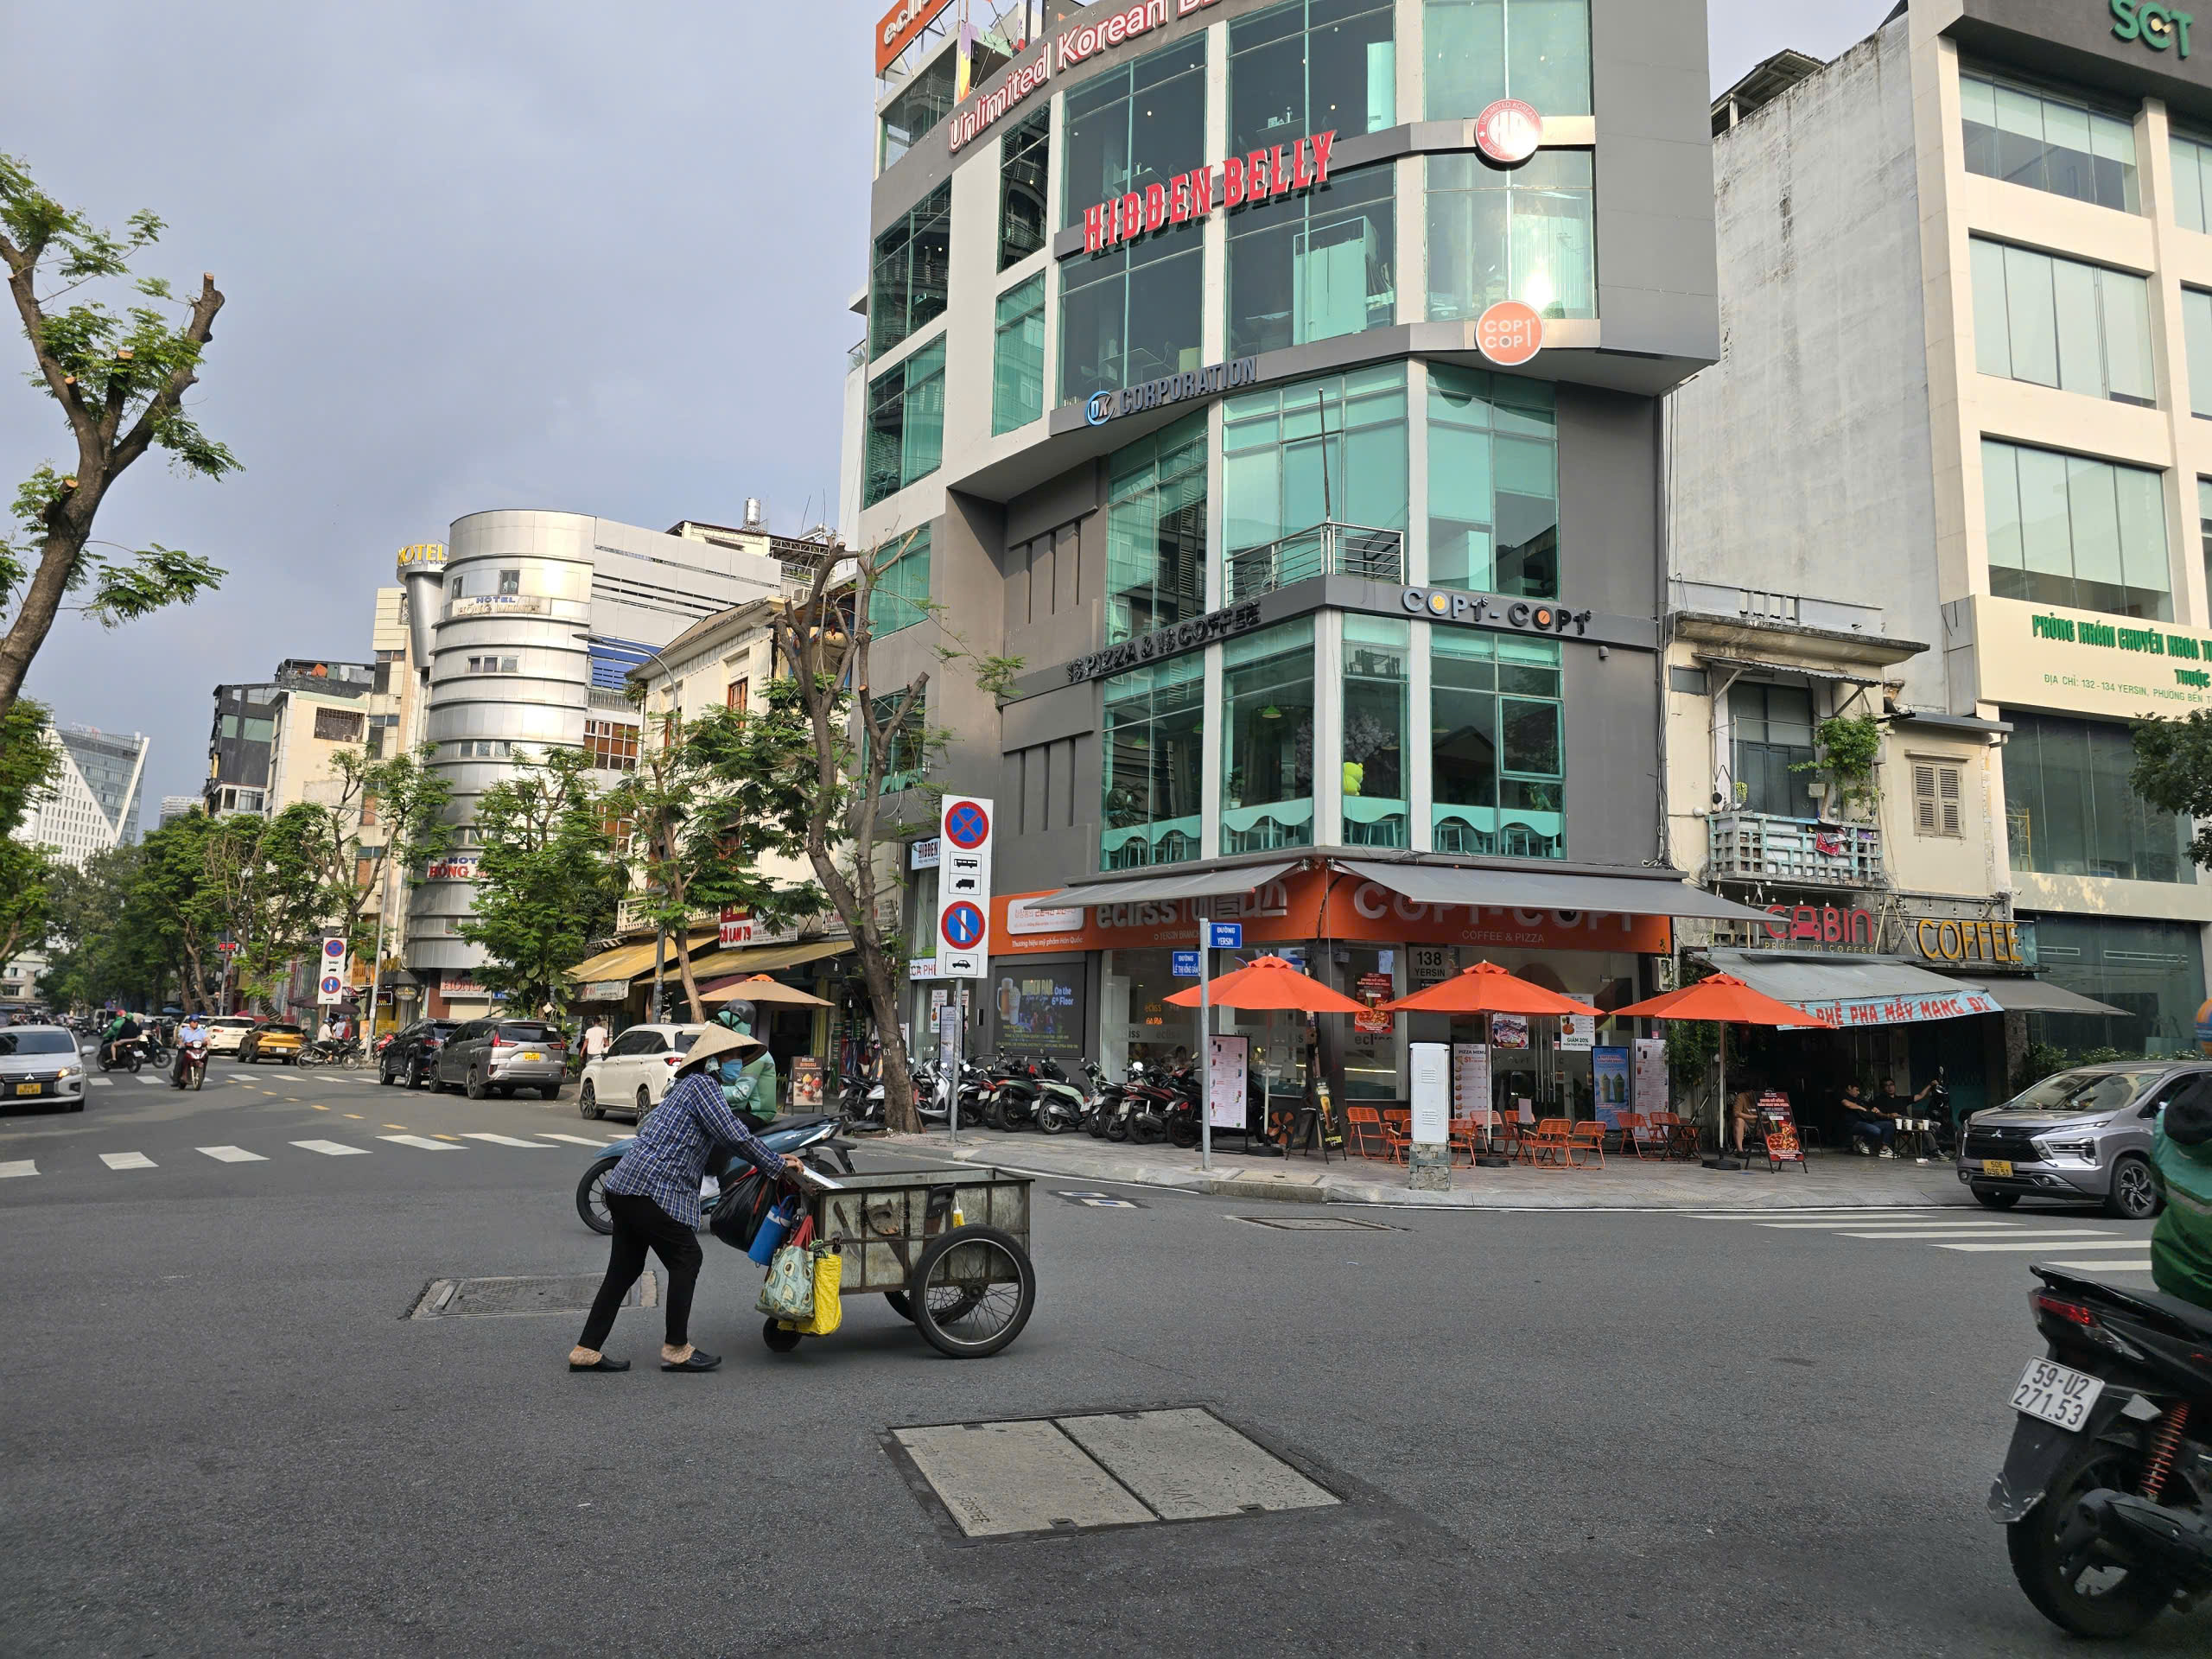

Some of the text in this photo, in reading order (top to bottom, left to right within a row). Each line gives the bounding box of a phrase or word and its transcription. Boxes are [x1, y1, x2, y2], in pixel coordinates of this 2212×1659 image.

[2111, 0, 2196, 59] SCT
[949, 0, 1168, 153] Unlimited Korean
[1480, 101, 1511, 125] UNLIMITED
[1223, 130, 1338, 208] BELLY
[1120, 357, 1257, 415] CORPORATION
[1084, 642, 1139, 677] PIZZA
[1178, 599, 1262, 647] COFFEE
[2032, 612, 2075, 643] PHÒNG
[2077, 620, 2117, 649] KHÁM
[2166, 634, 2200, 660] KHOA
[2081, 679, 2095, 690] 132
[2101, 682, 2115, 692] 134
[743, 925, 752, 942] 79
[1217, 937, 1234, 945] YERSIN
[1462, 930, 1545, 943] COFFEE & PIZZA
[1916, 918, 2023, 962] COFFEE
[1417, 951, 1442, 966] 138
[1828, 945, 1874, 954] COFFEE
[1414, 967, 1446, 977] YERSIN
[1058, 996, 1074, 1006] Floor
[1850, 1004, 1879, 1024] PHA
[1920, 998, 1965, 1019] MANG
[2032, 1363, 2090, 1401] 59-U2
[2013, 1384, 2084, 1426] 271.53
